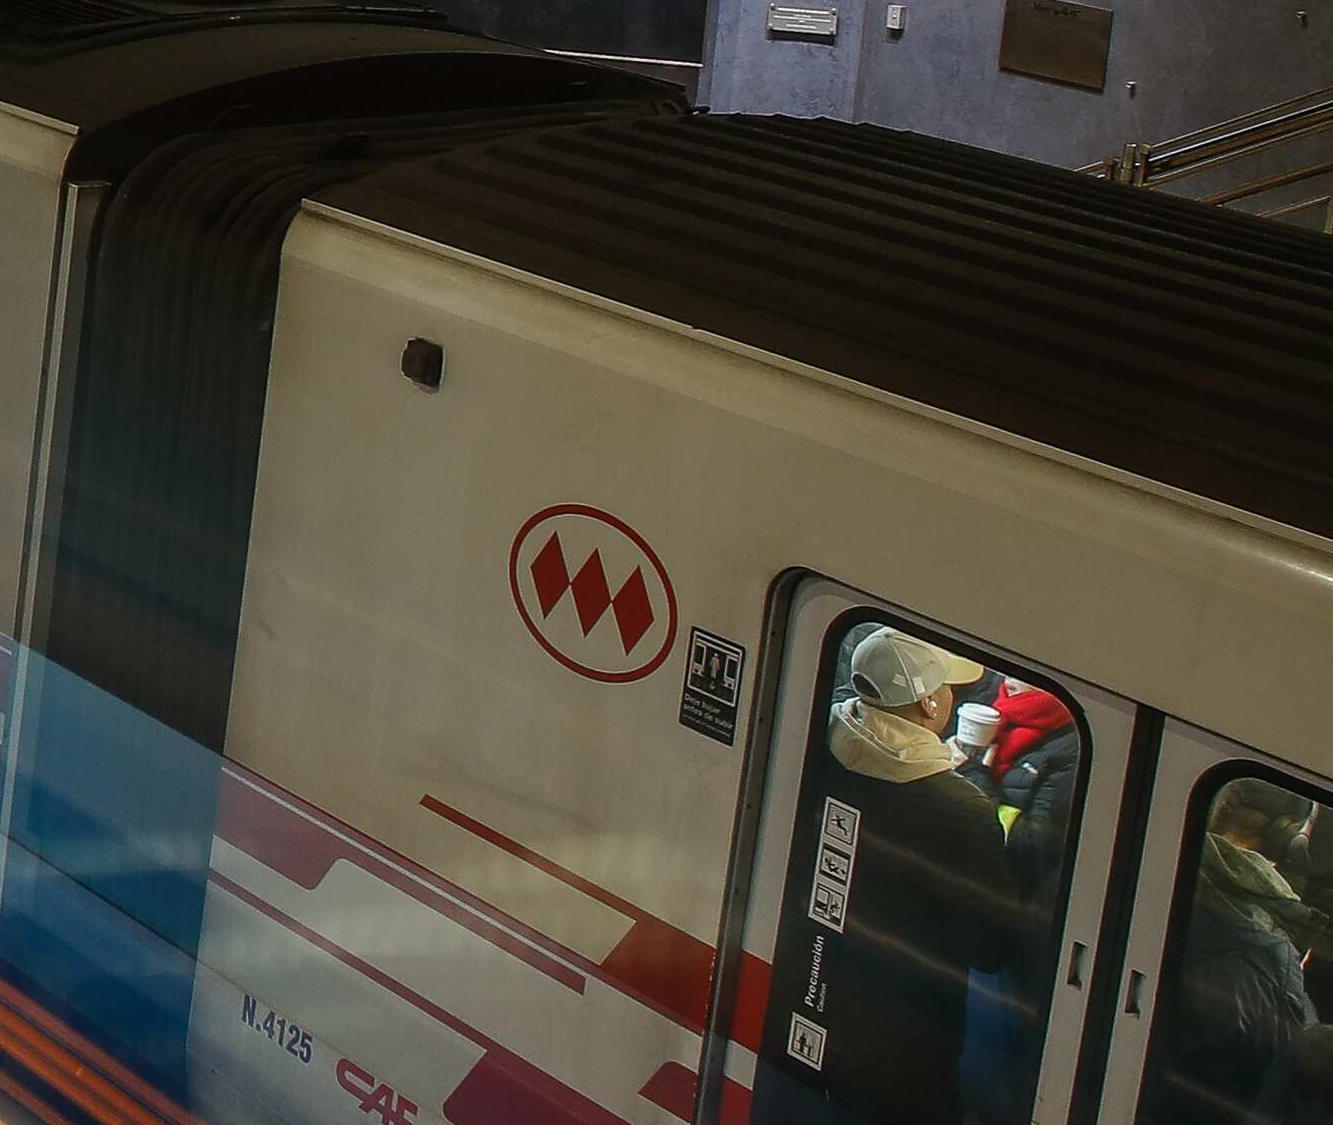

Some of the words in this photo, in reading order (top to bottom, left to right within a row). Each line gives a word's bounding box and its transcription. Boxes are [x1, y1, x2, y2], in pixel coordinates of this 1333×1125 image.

[804, 934, 826, 1008] Precaución
[241, 993, 313, 1064] N.4125
[336, 1058, 420, 1125] CAF
